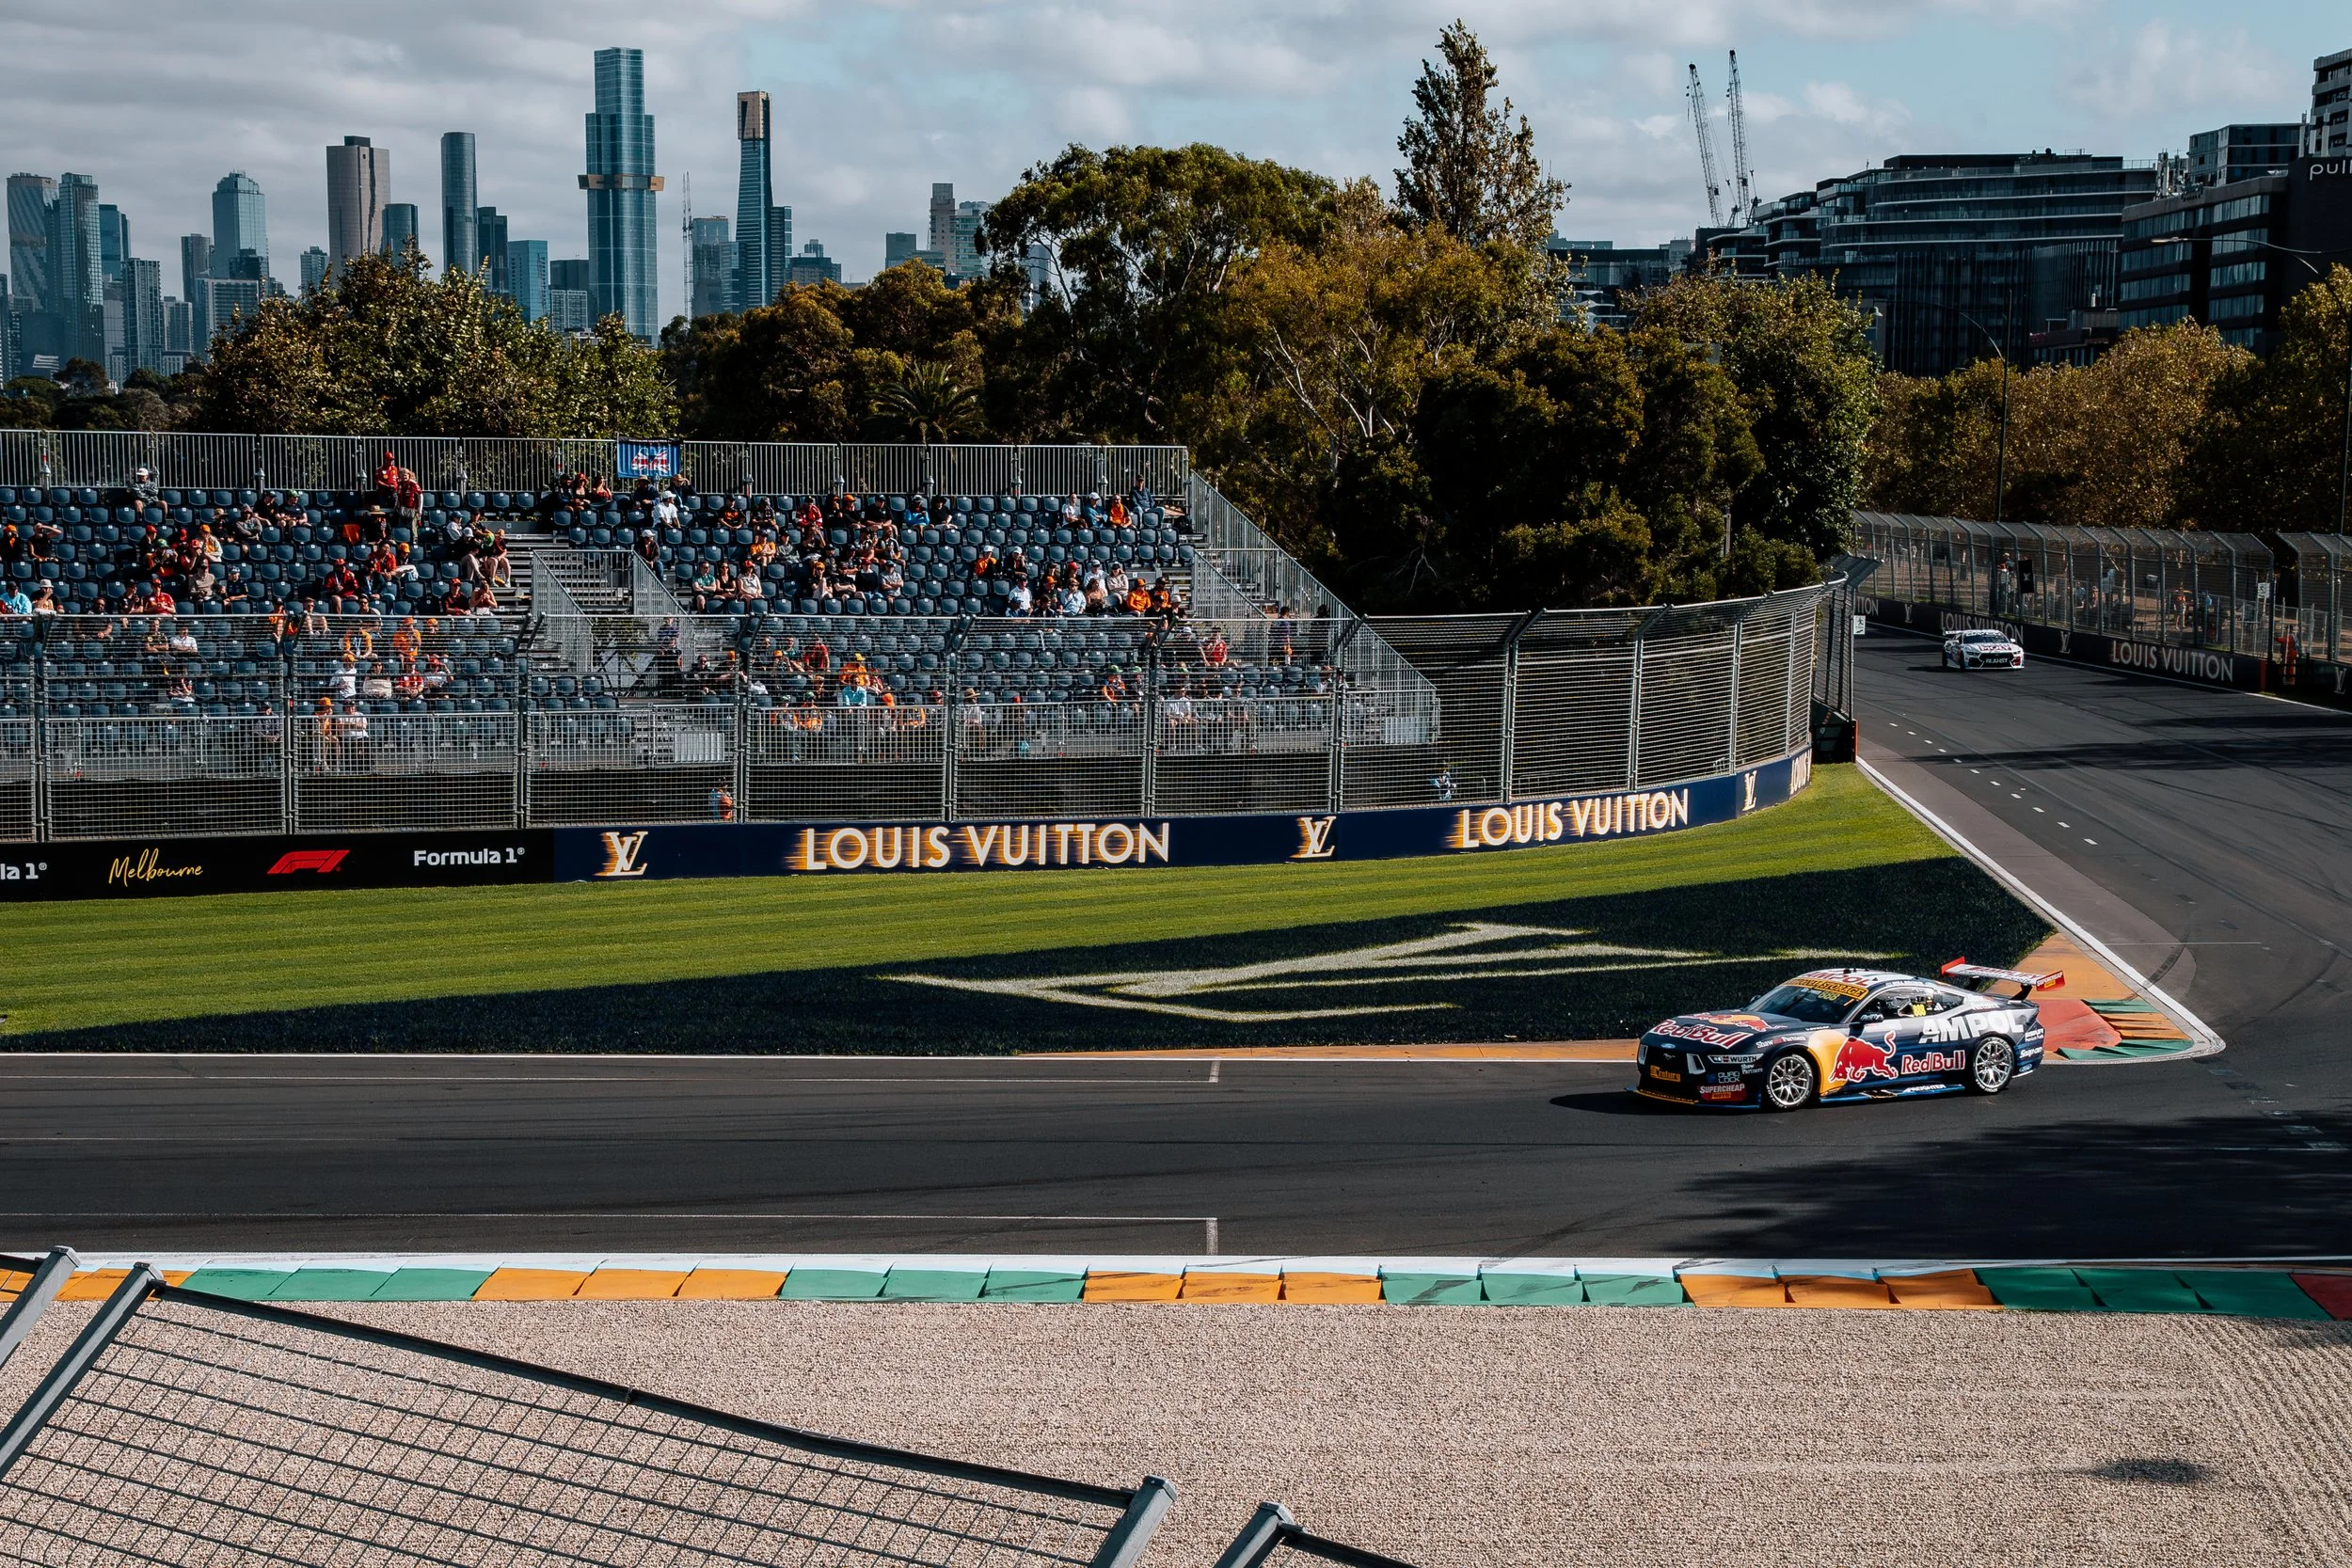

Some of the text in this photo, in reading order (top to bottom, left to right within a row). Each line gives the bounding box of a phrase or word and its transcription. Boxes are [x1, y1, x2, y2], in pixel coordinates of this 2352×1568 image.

[1857, 595, 1879, 616] TTON
[1941, 611, 1972, 631] LOUIS
[2112, 641, 2233, 682] LOUIS VUITTON
[1463, 789, 1689, 848] LOUIS VUITTON
[414, 847, 501, 866] Formula
[806, 822, 1170, 870] LOUIS VUITTON
[108, 848, 204, 887] Melbourne
[1821, 981, 1866, 999] STORAGE
[1918, 1009, 2024, 1043] AMPOL
[1756, 1039, 1773, 1049] Shaw
[1699, 1083, 1745, 1094] SUPERCHEAP
